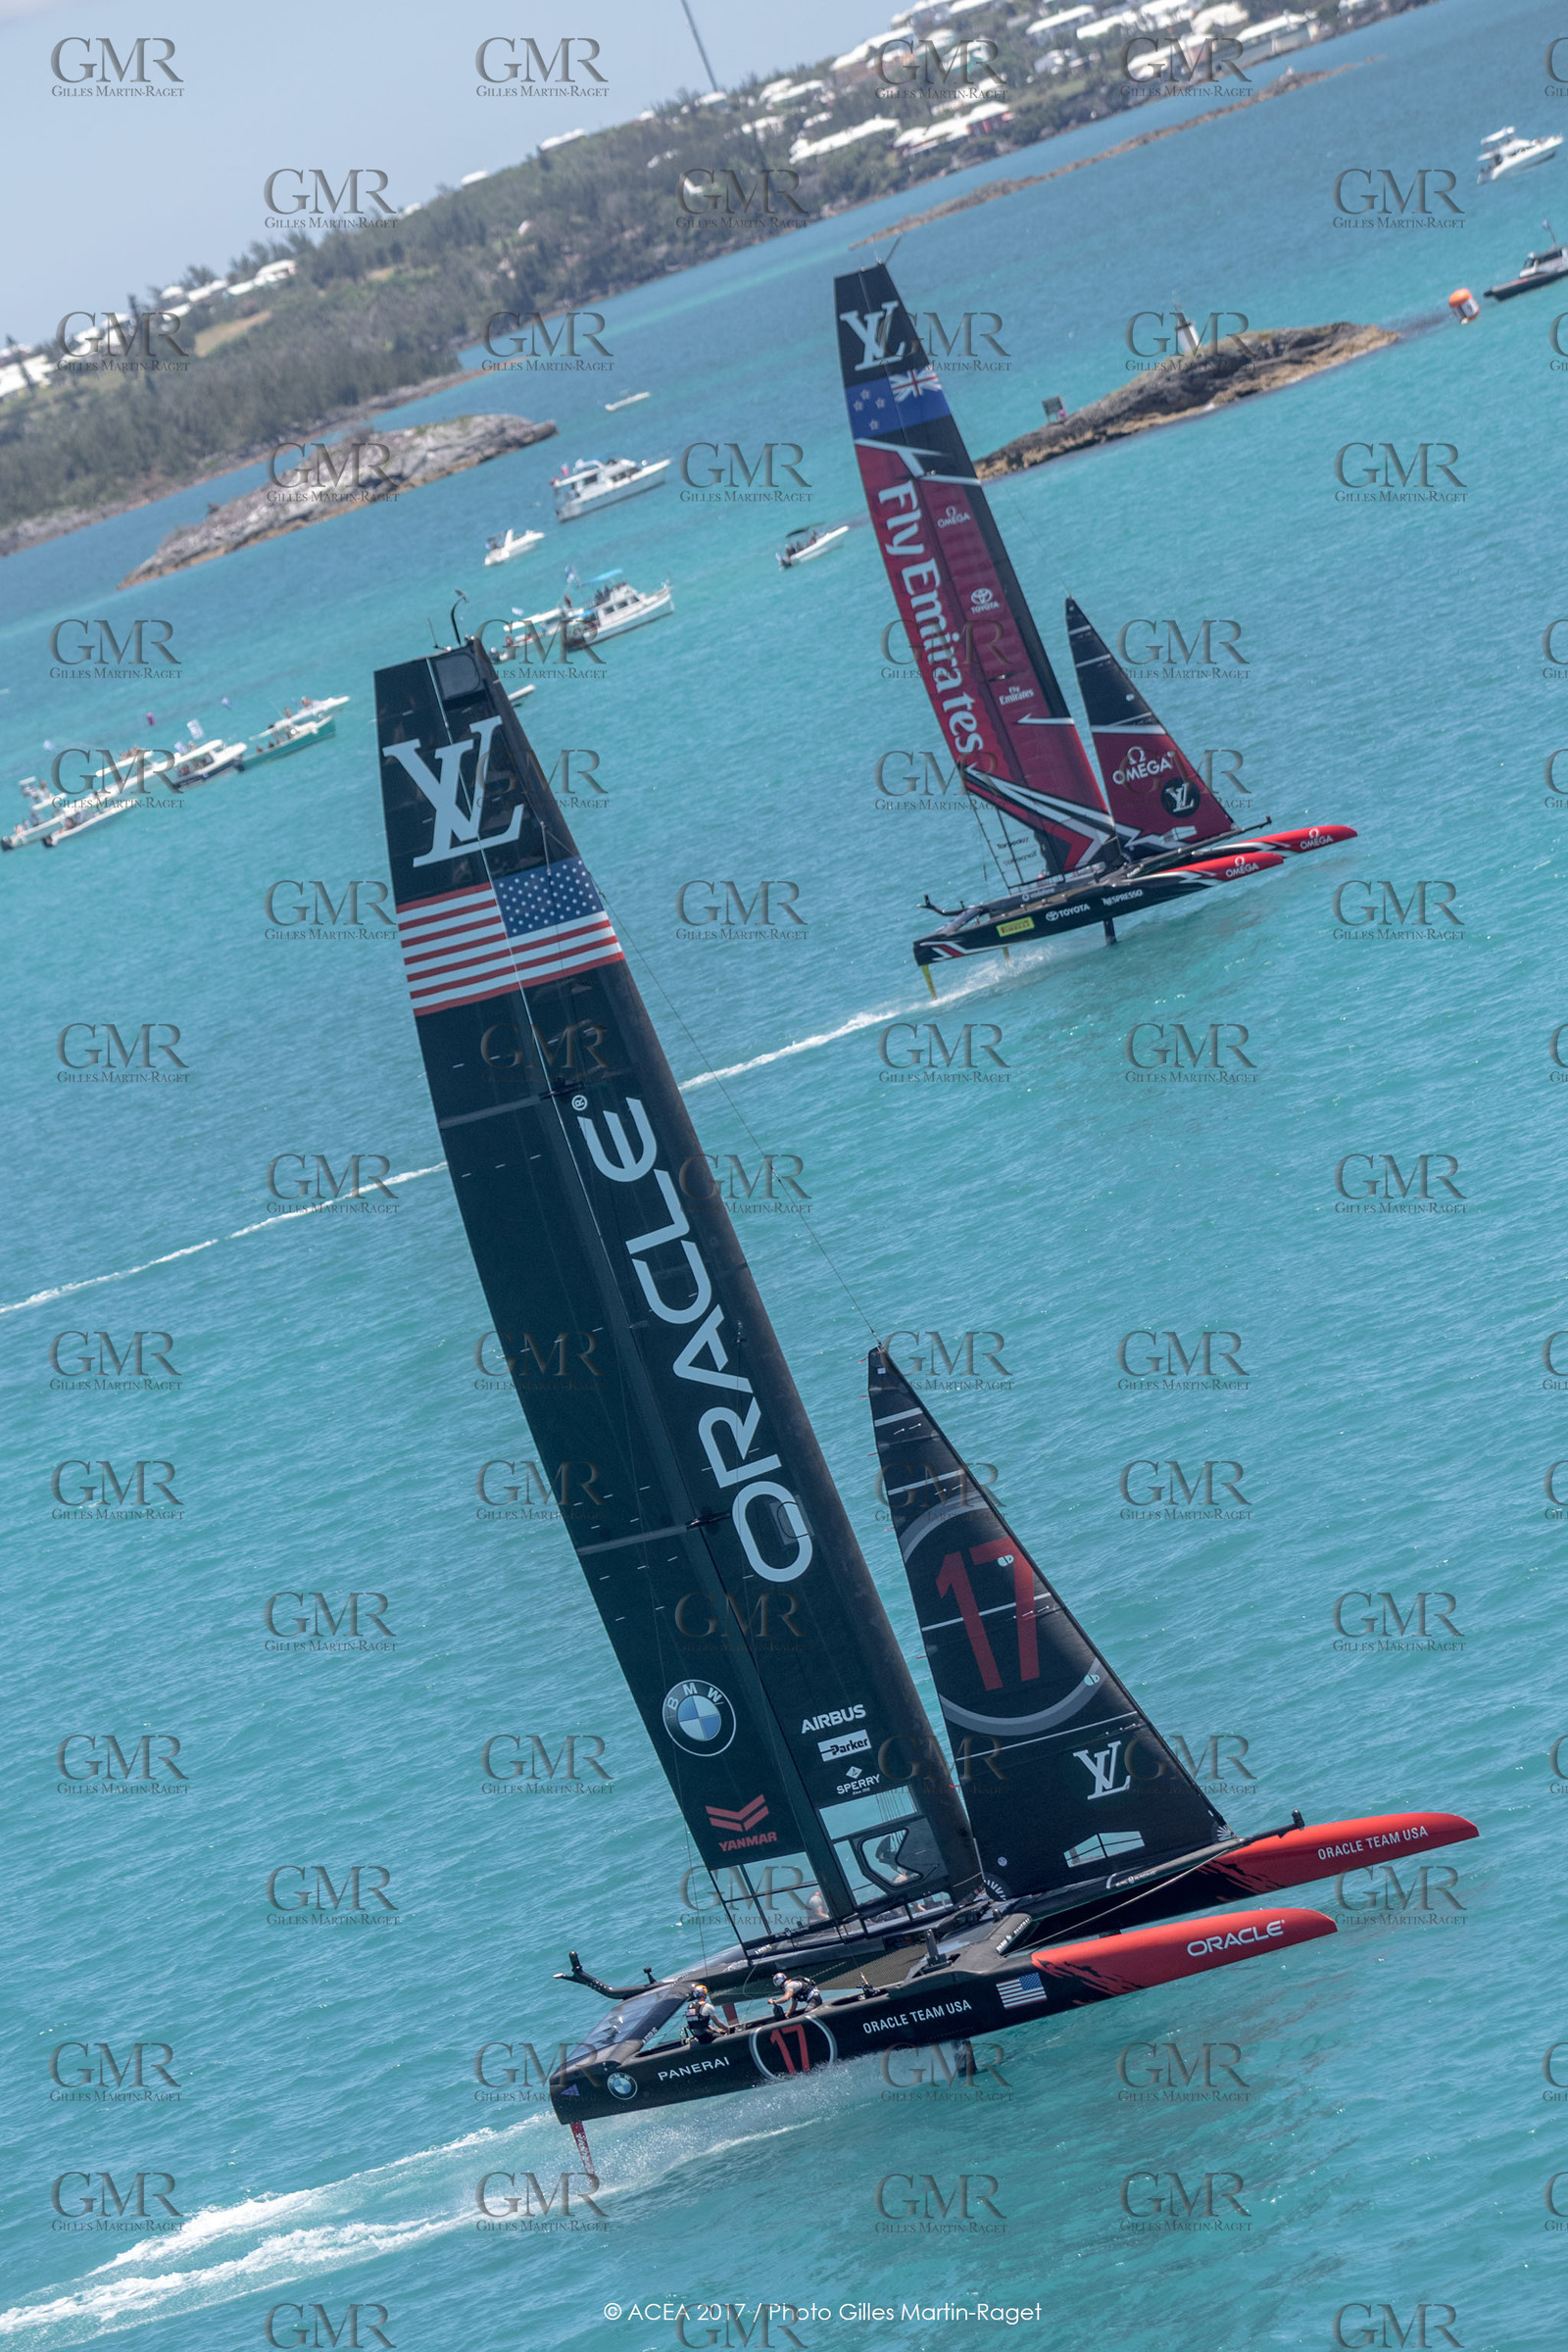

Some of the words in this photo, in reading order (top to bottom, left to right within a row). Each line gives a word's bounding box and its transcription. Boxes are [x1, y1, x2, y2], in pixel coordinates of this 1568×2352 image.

[937, 513, 971, 528] OMEGA
[970, 600, 1000, 613] TOYOTA
[878, 480, 924, 555] Fly
[902, 558, 984, 754] Emirates
[999, 689, 1034, 706] Emirates
[1112, 758, 1173, 785] OMEGA
[1299, 835, 1334, 851] OMEGA
[1225, 862, 1259, 878] OMEGA
[1101, 889, 1144, 906] NESPRESSO
[1058, 904, 1091, 918] TOYOTA
[935, 1537, 1040, 1691] 17
[667, 1682, 723, 1711] BMW
[801, 1704, 866, 1734] AIRBUS
[829, 1737, 869, 1756] Parker
[836, 1774, 880, 1794] SPERRY
[718, 1832, 777, 1852] YANMAR
[1317, 1839, 1364, 1860] ORACLE
[1366, 1831, 1400, 1848] TEAM
[1402, 1826, 1429, 1841] USA
[862, 2013, 909, 2034] ORACLE
[911, 2005, 946, 2023] TEAM
[946, 1999, 972, 2014] USA
[769, 2024, 810, 2074] 17
[658, 2057, 730, 2081] PANERAI
